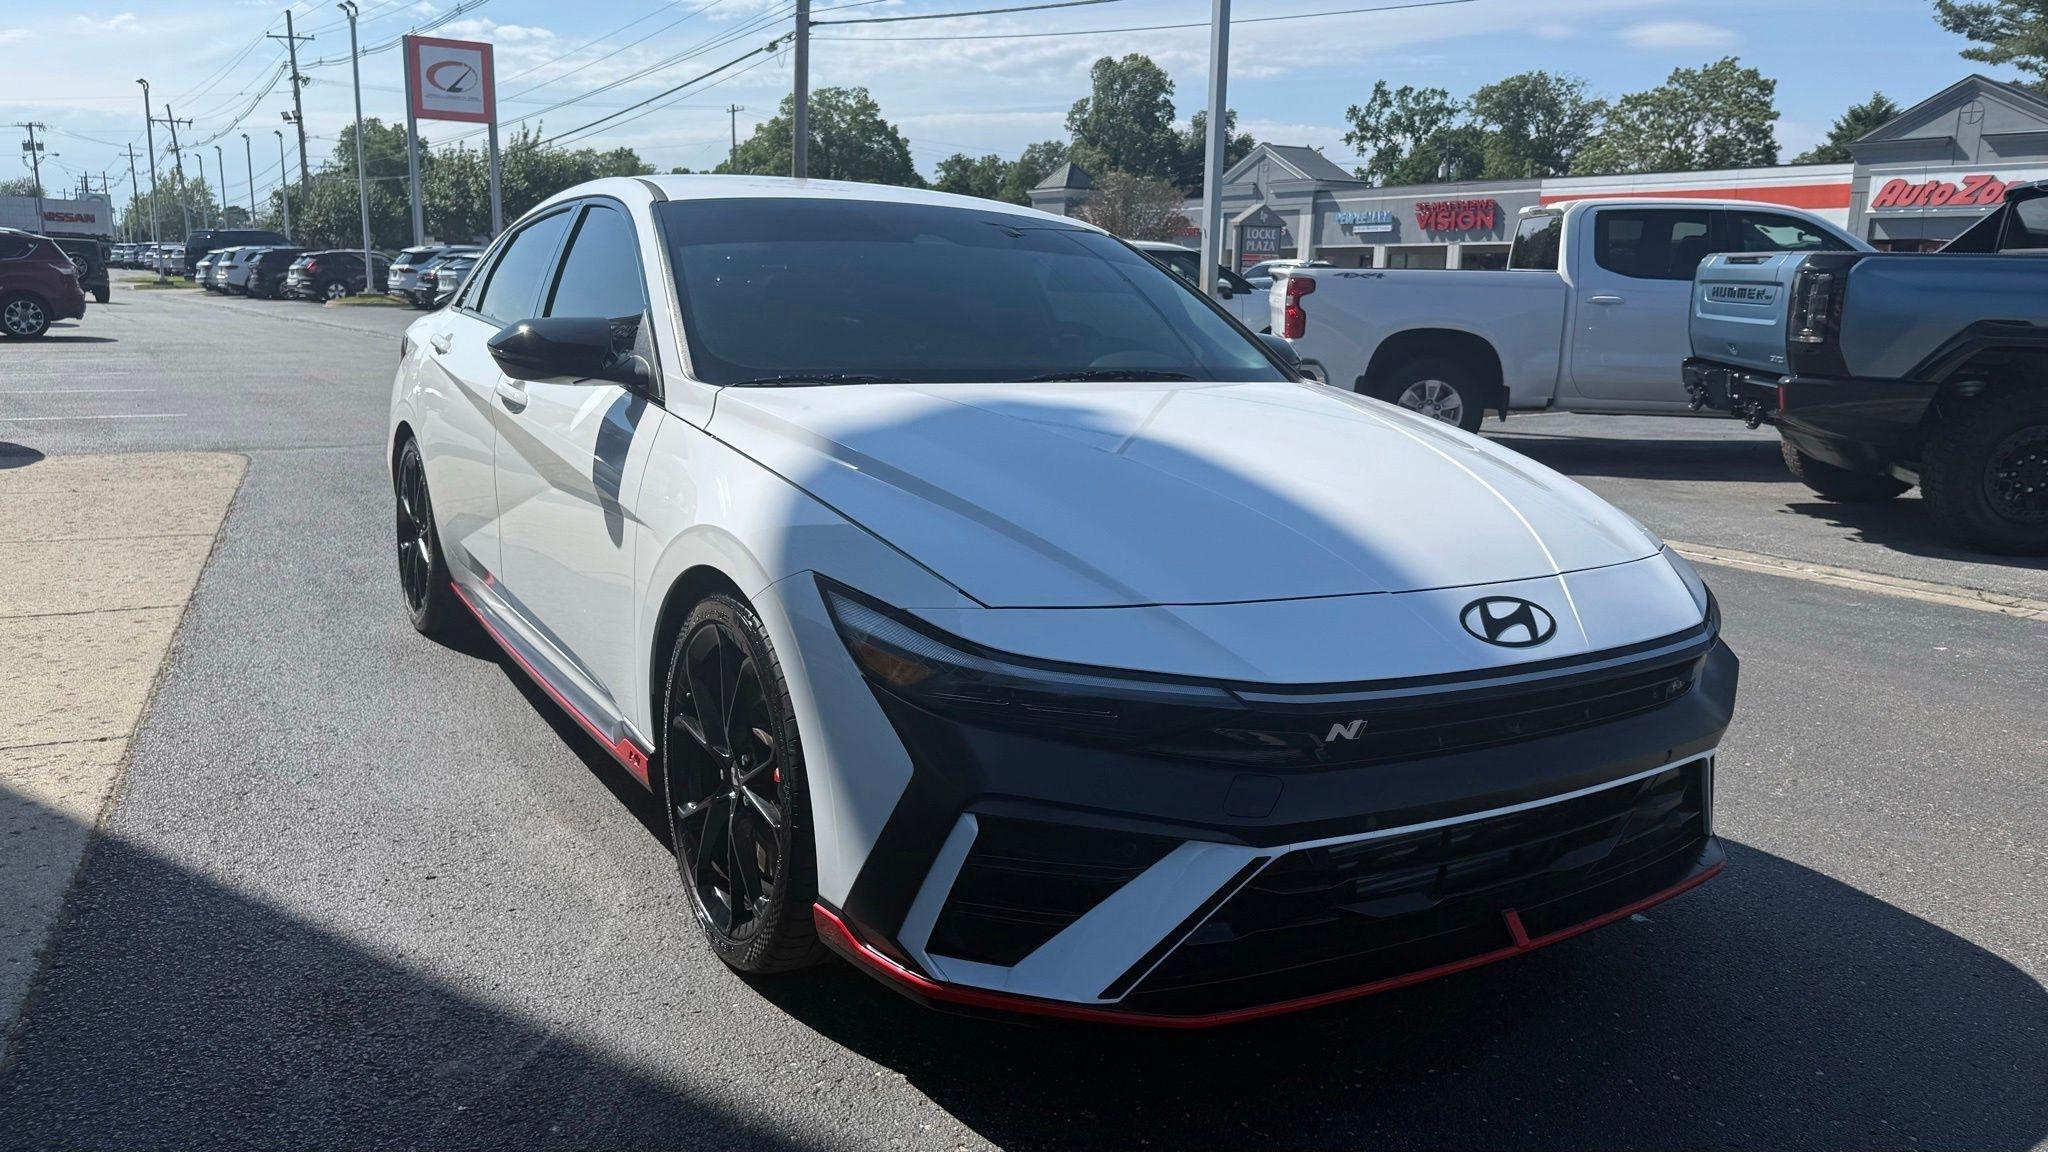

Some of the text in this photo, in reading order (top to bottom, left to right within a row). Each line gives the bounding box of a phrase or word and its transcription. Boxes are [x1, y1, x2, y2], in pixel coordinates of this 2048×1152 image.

[1415, 211, 1494, 231] VISION
[1246, 228, 1276, 240] LOCKE
[1246, 240, 1275, 251] PLAZA
[1712, 286, 1766, 300] HUMMER
[1325, 719, 1368, 742] N
